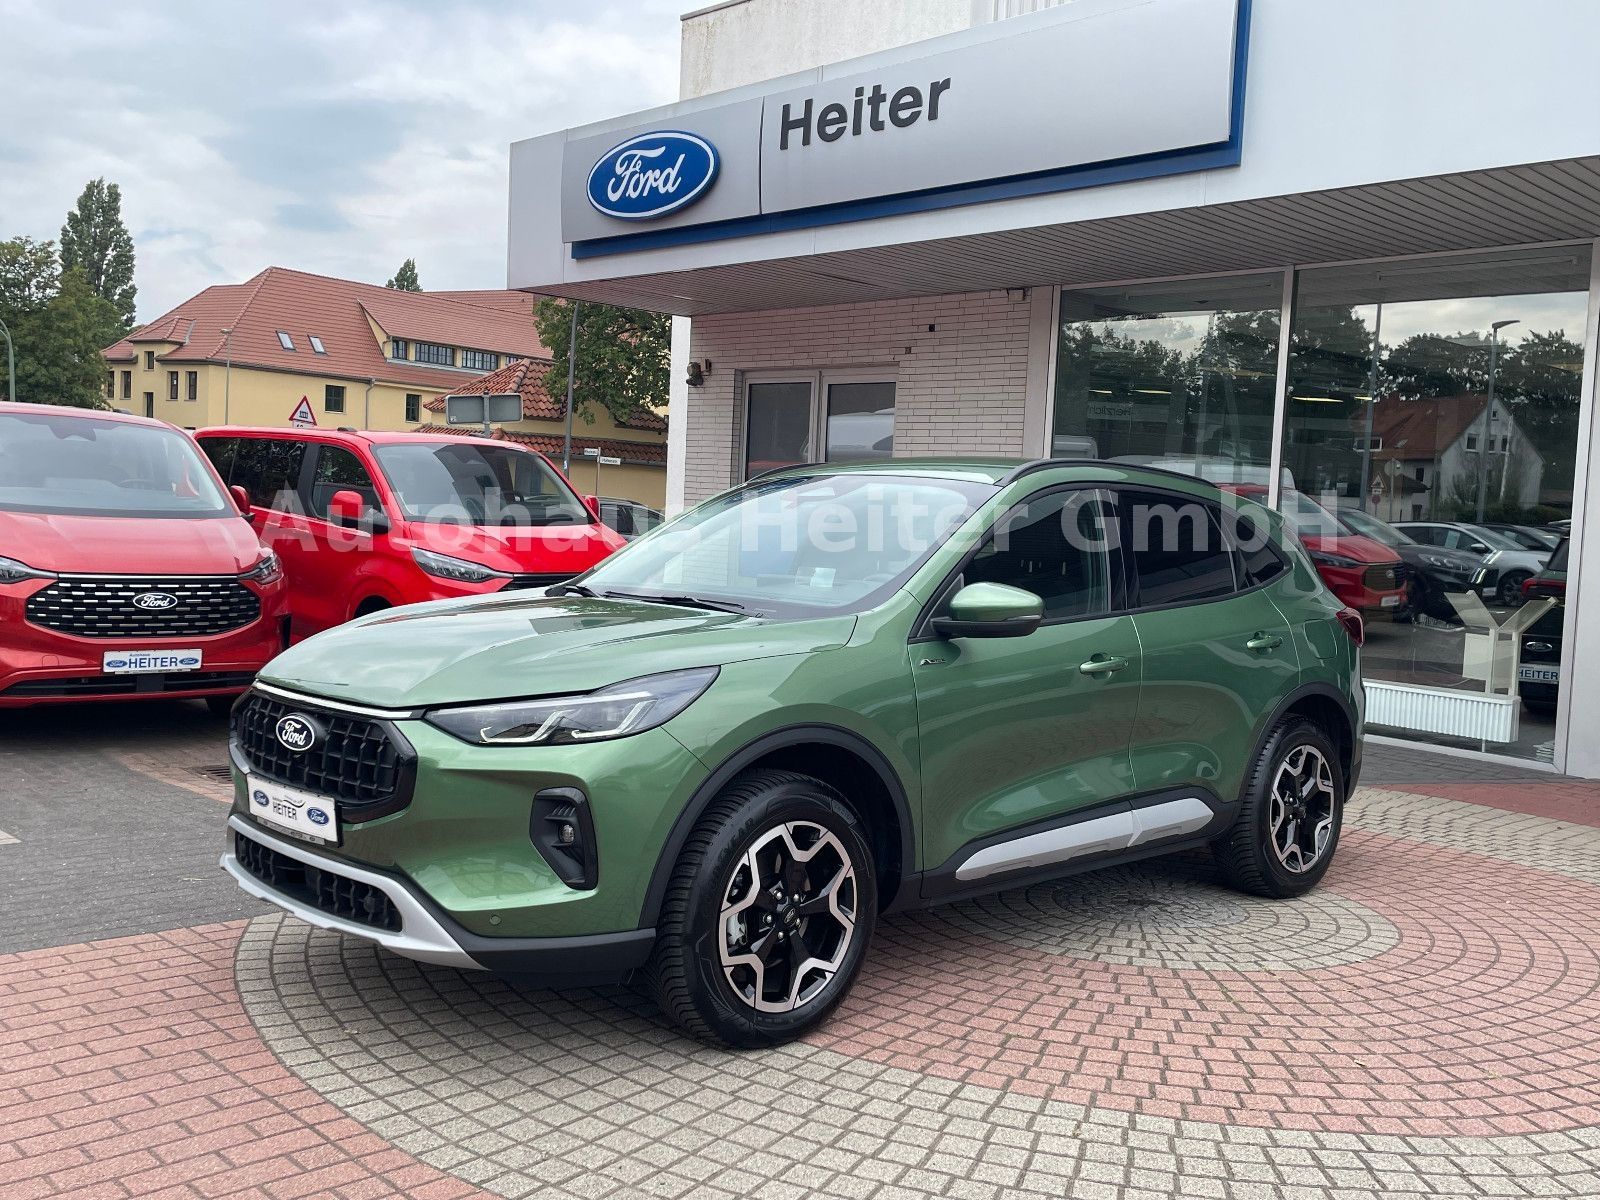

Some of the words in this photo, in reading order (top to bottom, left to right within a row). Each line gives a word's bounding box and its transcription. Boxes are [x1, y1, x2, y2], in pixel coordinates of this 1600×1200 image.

[779, 77, 951, 150] Heiter
[607, 145, 685, 202] Ford
[140, 594, 170, 607] Ford
[128, 657, 178, 668] HEITER
[282, 720, 307, 746] Ford
[272, 801, 298, 821] HEITER
